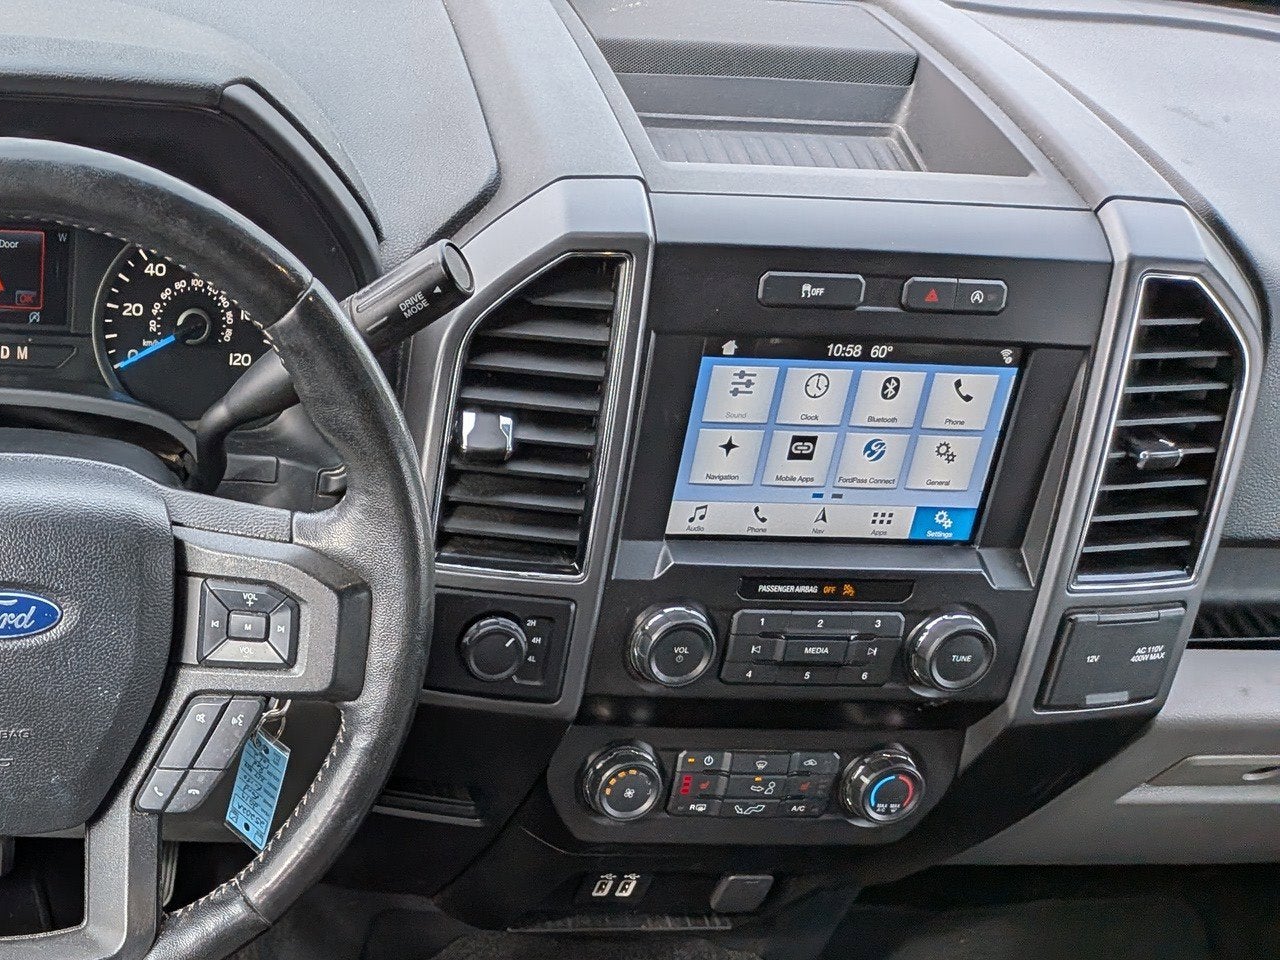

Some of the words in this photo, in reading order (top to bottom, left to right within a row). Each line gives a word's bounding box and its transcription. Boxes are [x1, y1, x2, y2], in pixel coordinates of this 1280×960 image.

[58, 233, 67, 242] W
[0, 240, 18, 248] Door
[144, 263, 166, 276] 40
[174, 280, 186, 290] 80
[191, 278, 204, 288] 100
[160, 288, 172, 300] 60
[812, 287, 825, 297] OFF
[398, 291, 424, 312] DRIVE
[122, 303, 144, 316] 20
[152, 302, 160, 316] 40
[404, 299, 430, 318] MODE
[150, 320, 156, 332] 20
[0, 346, 10, 360] D
[16, 346, 28, 360] M
[826, 344, 862, 358] 10:58
[229, 353, 252, 366] 120
[724, 411, 746, 419] Sound
[868, 415, 898, 423] Bluetooth
[944, 418, 965, 426] Phone
[706, 473, 740, 481] Navigation
[775, 474, 796, 482] Mobile
[838, 476, 868, 484] FordPass
[746, 526, 767, 534] Phone
[871, 530, 887, 538] Apps
[926, 530, 954, 538] Settings
[758, 584, 794, 593] PASSENGER
[795, 585, 818, 594] AIRBAG
[823, 586, 836, 594] OFF
[242, 592, 258, 601] VOL
[760, 618, 764, 626] 1
[818, 620, 824, 628] 2
[874, 620, 882, 628] 3
[240, 646, 254, 654] VOL
[674, 646, 690, 654] VOL
[804, 646, 828, 654] MEDIA
[1147, 644, 1164, 654] 110V
[952, 654, 972, 662] TUNE
[1086, 655, 1100, 663] 12V
[1149, 652, 1166, 661] MAX
[746, 670, 752, 678] 4
[804, 672, 810, 680] 5
[862, 672, 868, 680] 6
